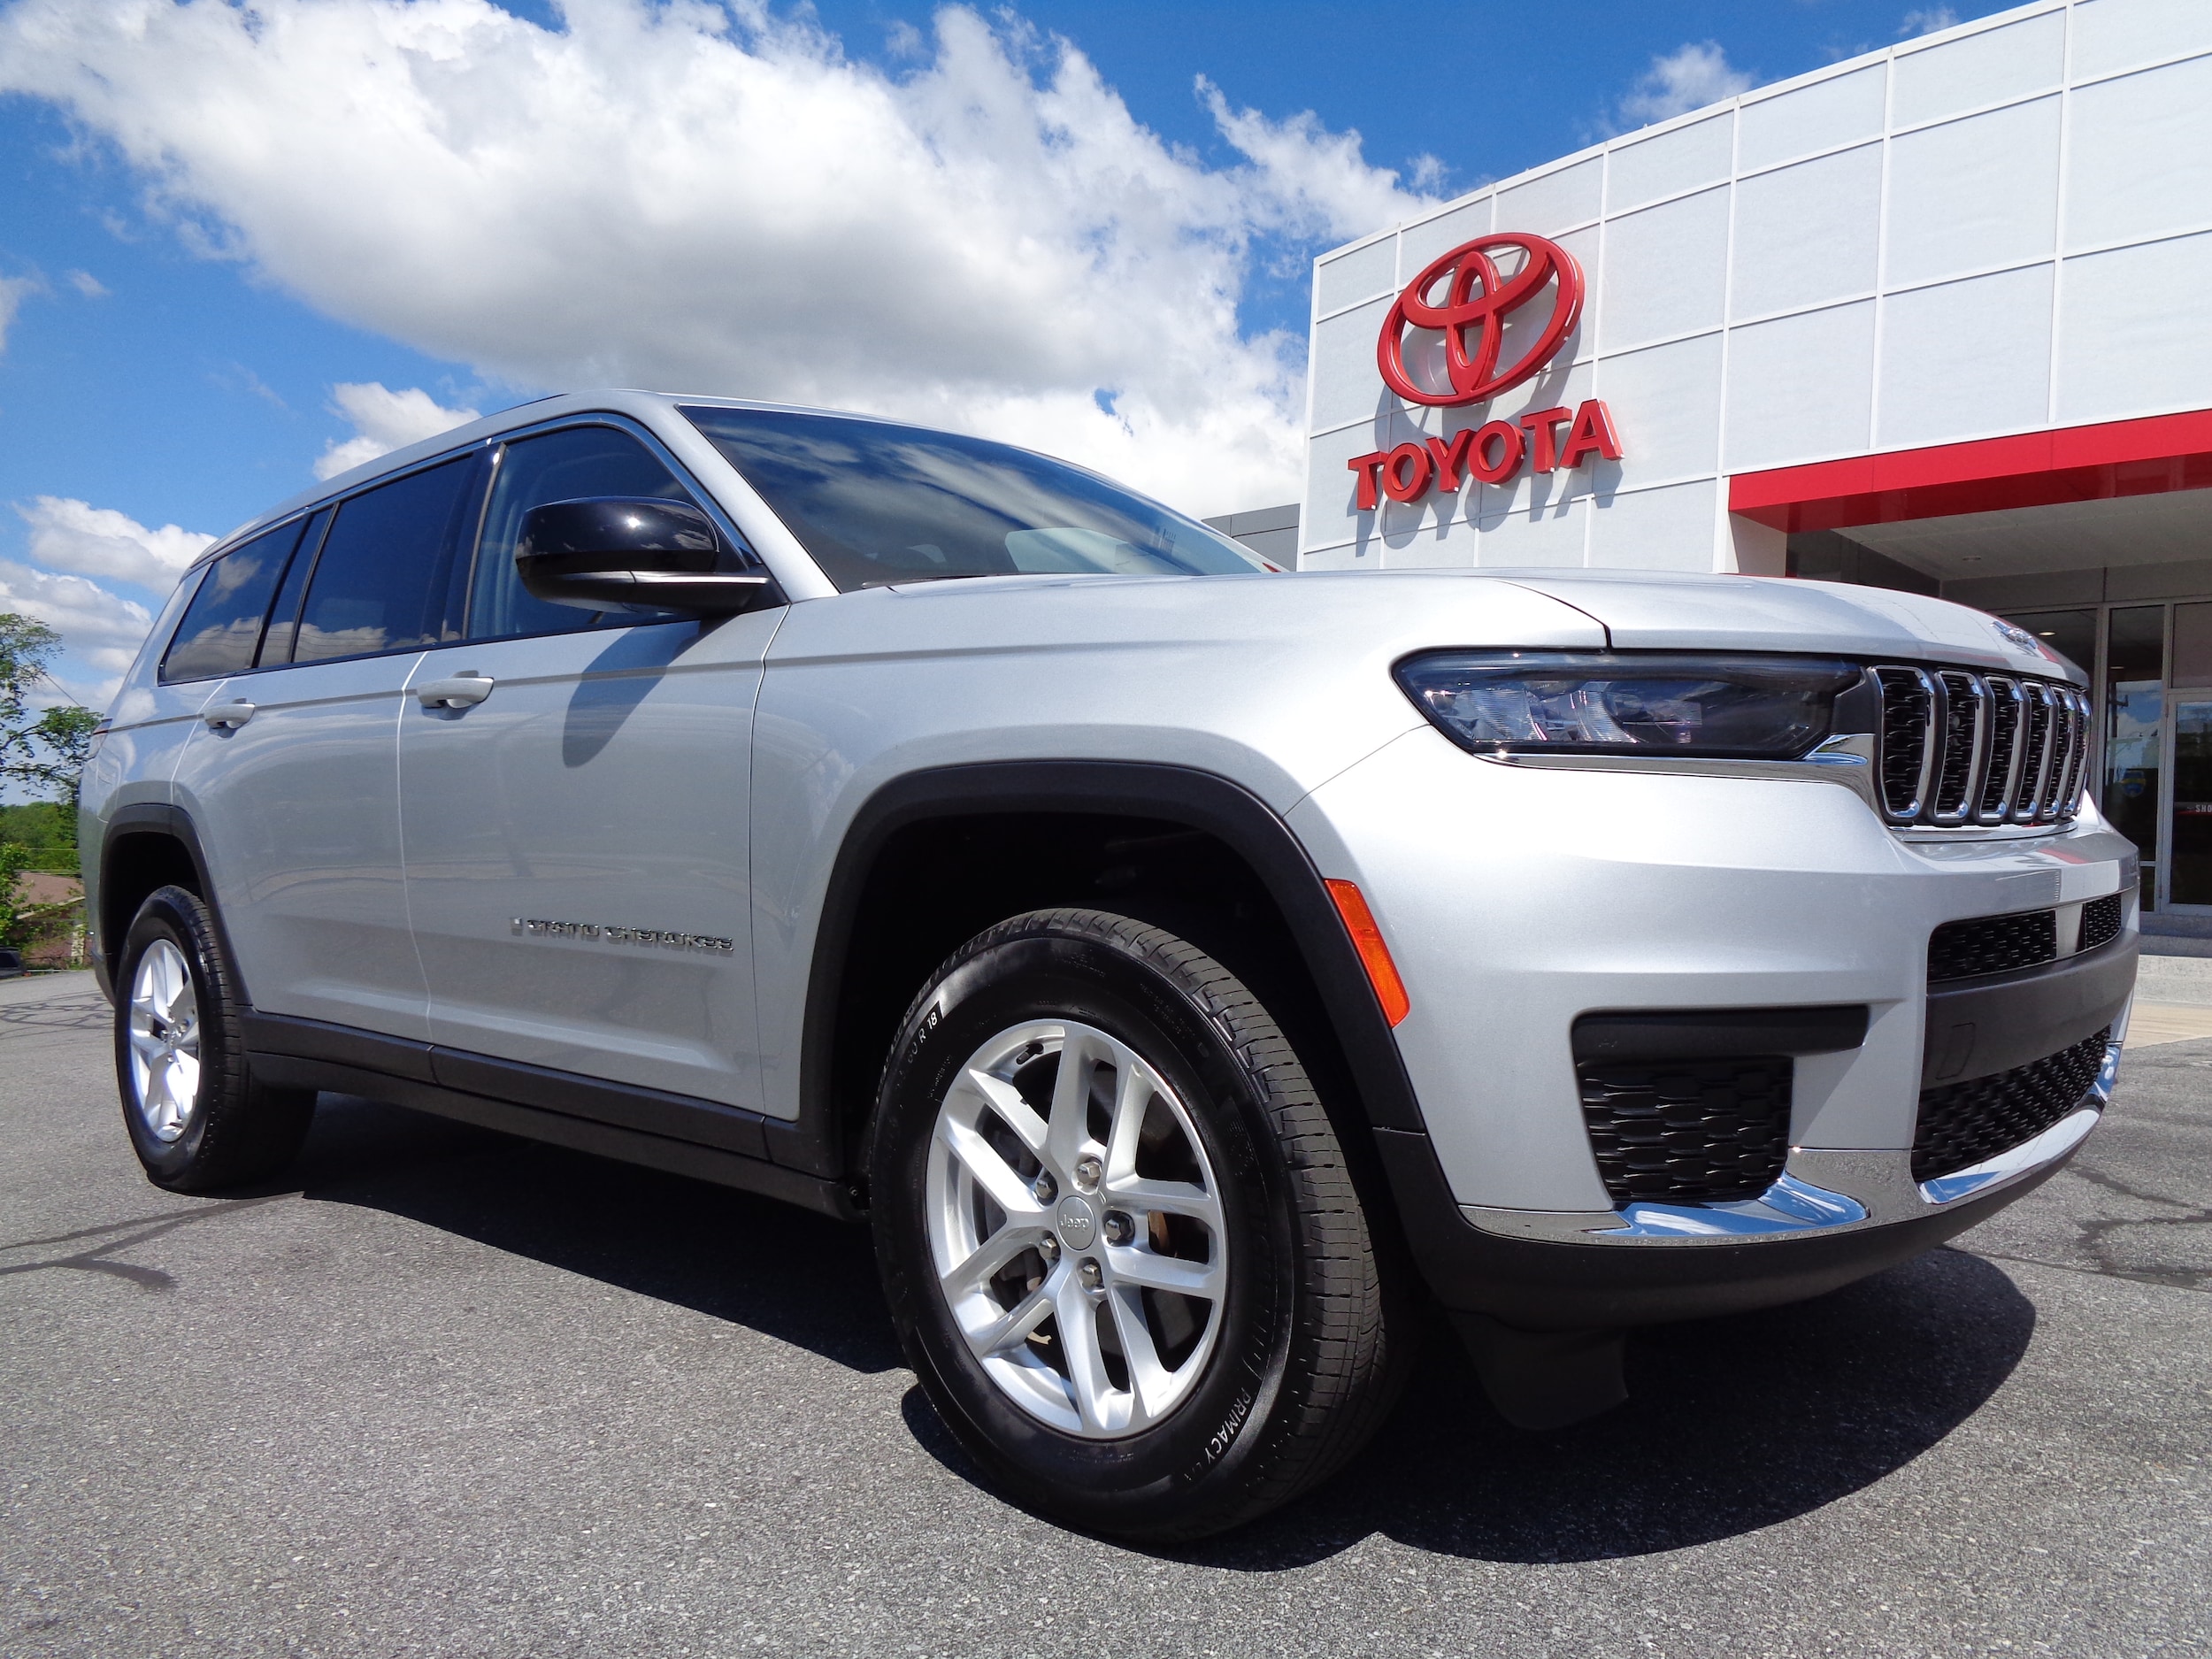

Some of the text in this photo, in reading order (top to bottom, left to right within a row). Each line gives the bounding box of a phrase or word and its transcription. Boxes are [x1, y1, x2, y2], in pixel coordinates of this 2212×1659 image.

[1348, 398, 1624, 511] TOYOTA
[604, 926, 733, 951] CHEROKEE
[1060, 1213, 1089, 1232] Jeep
[1205, 1386, 1252, 1464] PRIMACY
